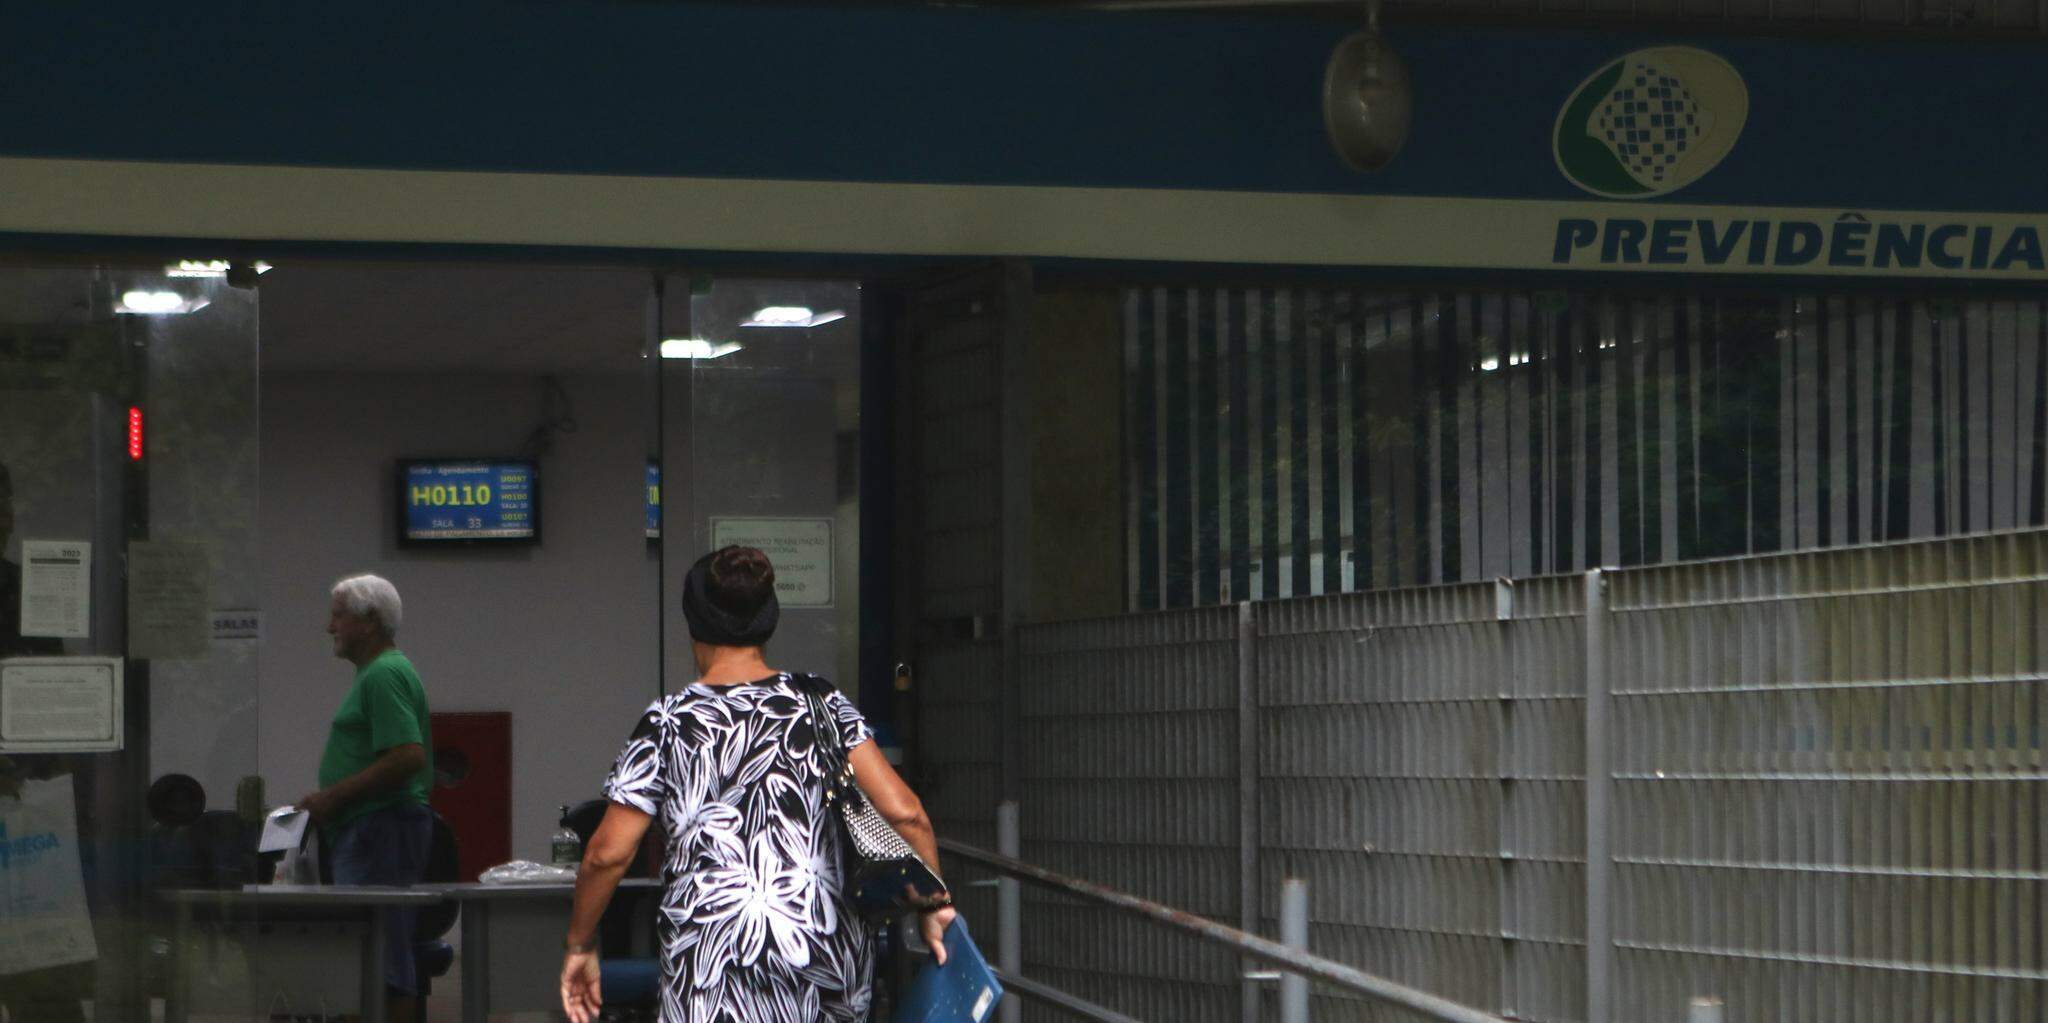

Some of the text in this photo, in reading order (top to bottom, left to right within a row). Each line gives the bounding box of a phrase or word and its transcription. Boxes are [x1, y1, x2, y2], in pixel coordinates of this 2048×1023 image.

[1552, 213, 2046, 270] PREVIDÊNCIA
[412, 483, 492, 507] H0110
[431, 517, 482, 529] SALA 33
[213, 618, 258, 631] SALAS
